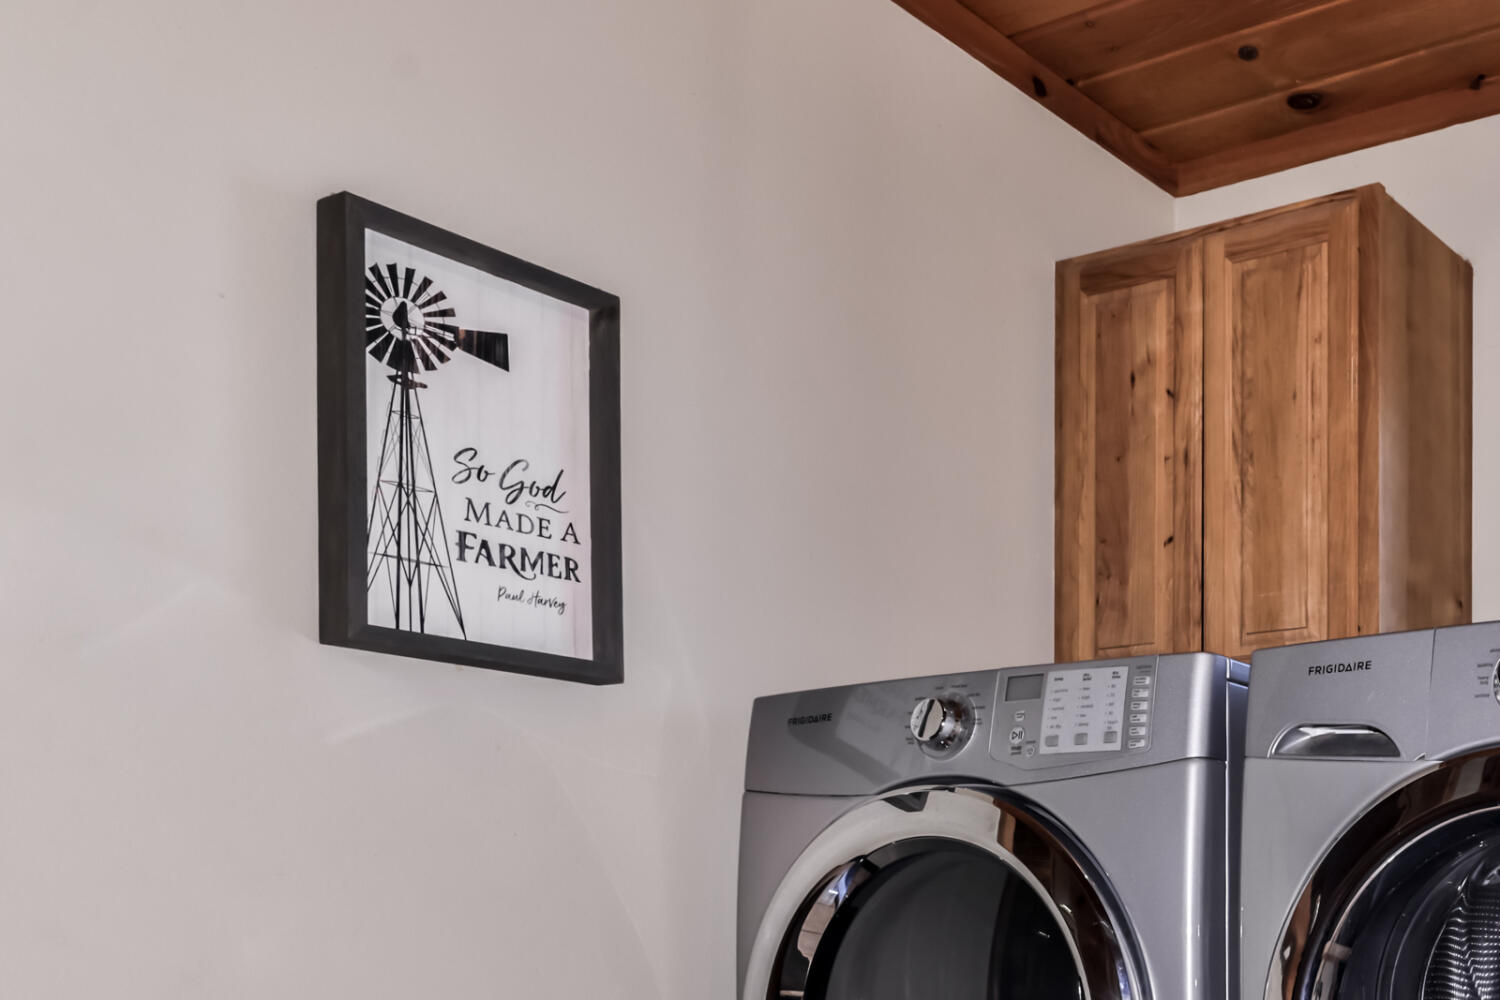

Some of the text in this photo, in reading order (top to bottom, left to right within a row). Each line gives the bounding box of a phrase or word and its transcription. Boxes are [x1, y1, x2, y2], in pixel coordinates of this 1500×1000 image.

[451, 447, 567, 505] So God
[464, 497, 581, 545] MADE A
[455, 530, 582, 583] FARMER
[497, 585, 567, 615] Paul Harvey
[1308, 660, 1373, 676] FRIGIDAIRE
